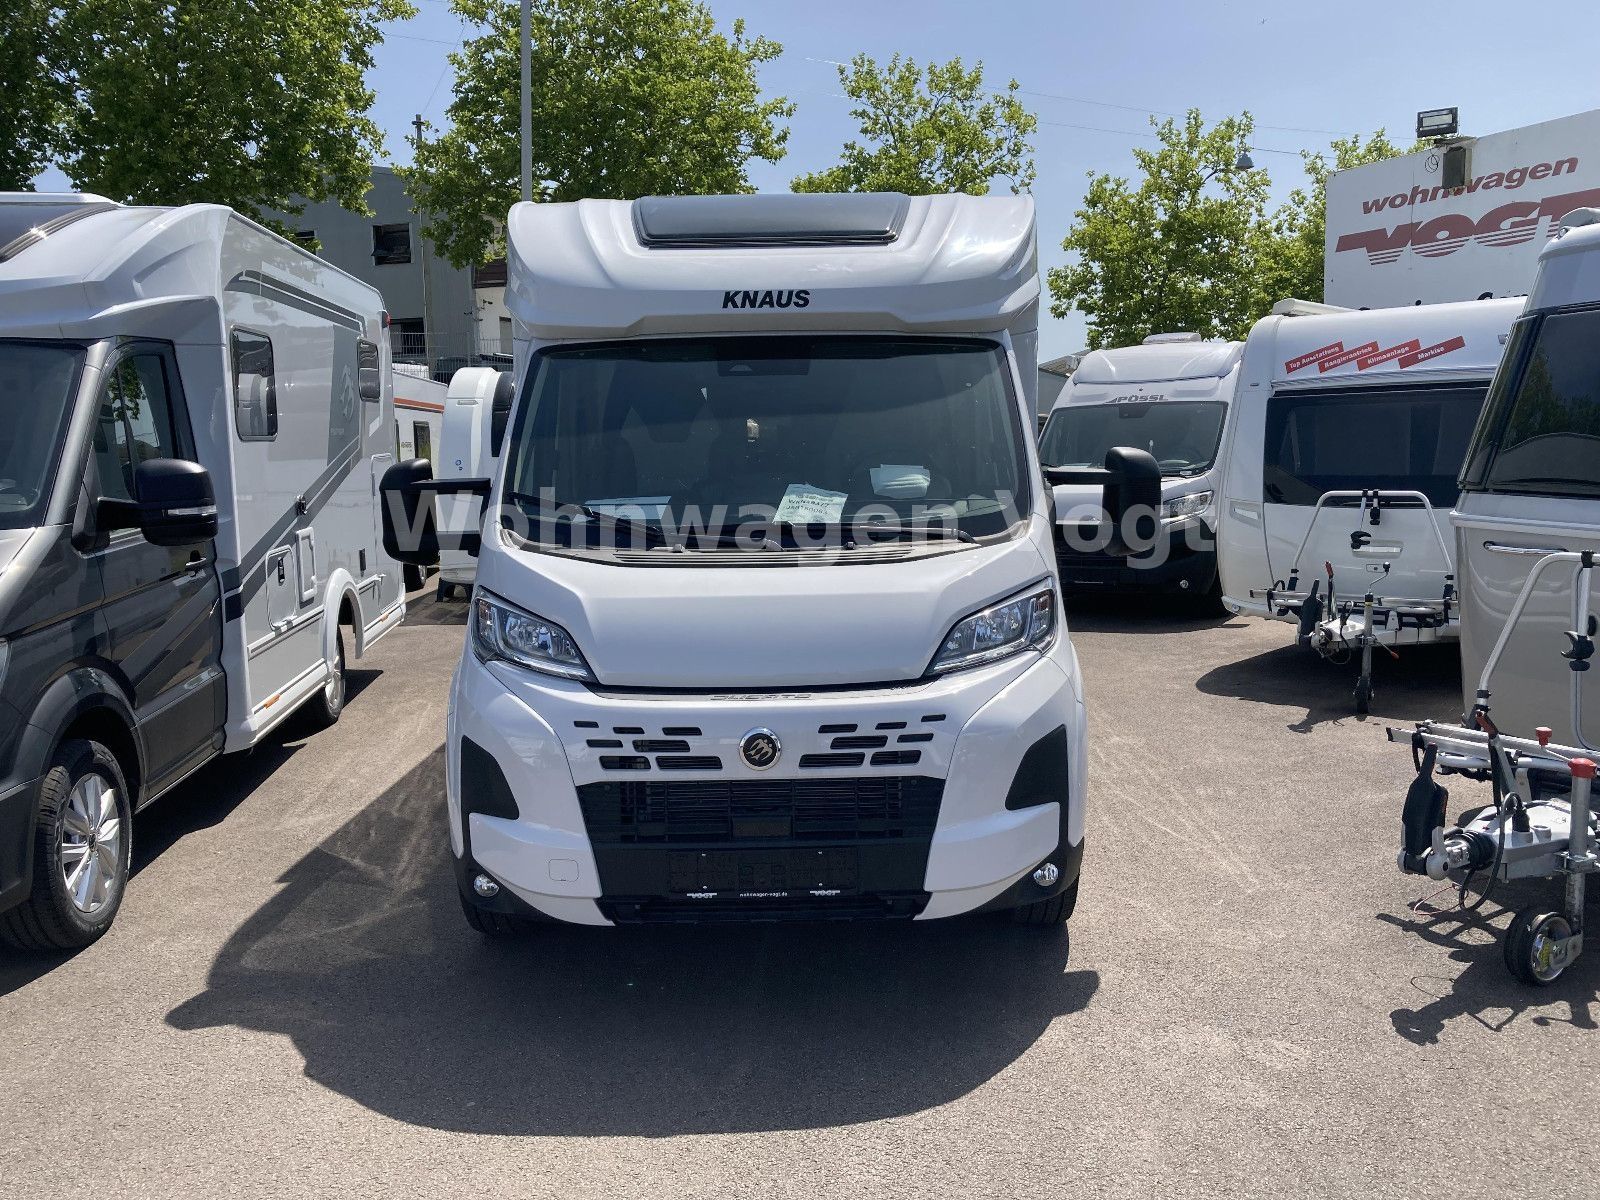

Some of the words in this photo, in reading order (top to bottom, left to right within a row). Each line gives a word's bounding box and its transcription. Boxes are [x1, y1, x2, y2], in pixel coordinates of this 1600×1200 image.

[1362, 157, 1579, 214] wohnwagen
[722, 289, 810, 309] KNAUS
[1417, 346, 1445, 361] Markise
[1289, 360, 1301, 370] Top
